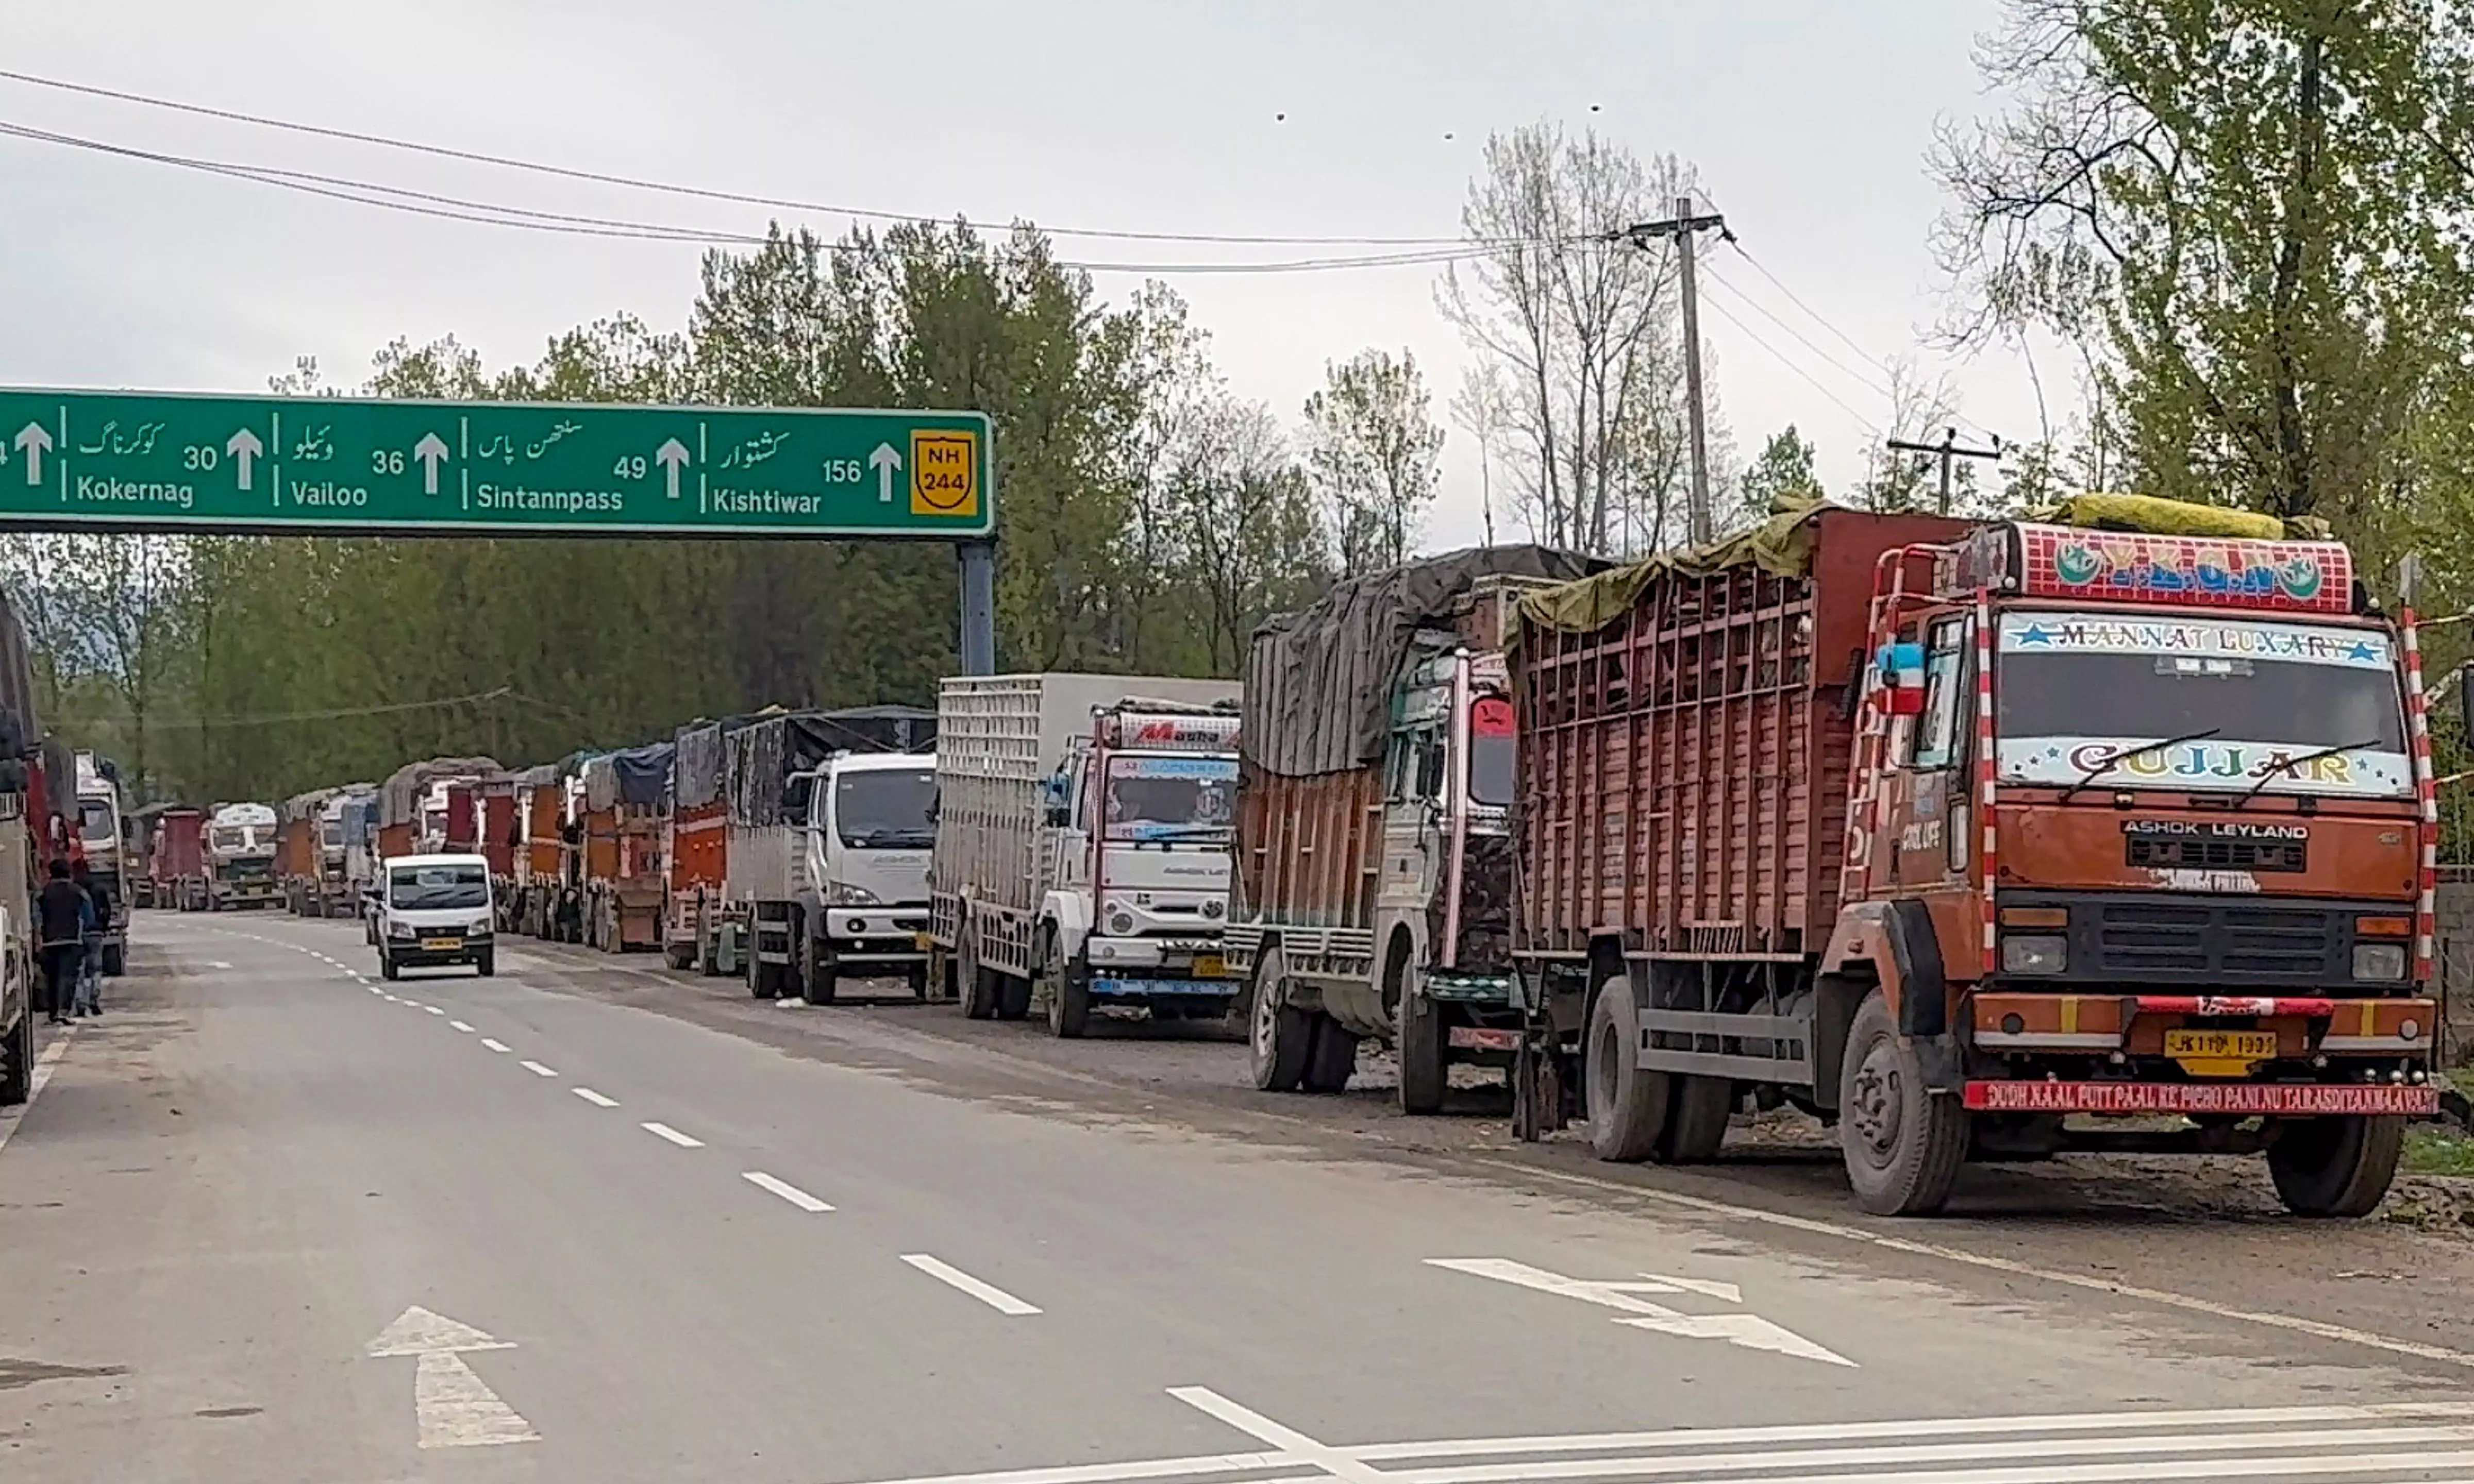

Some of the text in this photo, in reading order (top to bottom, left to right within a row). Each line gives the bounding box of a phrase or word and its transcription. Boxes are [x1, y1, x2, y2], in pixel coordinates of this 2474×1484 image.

[183, 445, 218, 471] 30
[372, 450, 405, 475] 36
[613, 456, 647, 479] 49
[928, 448, 960, 464] NH
[823, 460, 862, 483] 156
[924, 473, 965, 491] 244
[77, 476, 194, 509] Kokernag
[291, 481, 367, 507] Vailoo
[477, 484, 623, 514] Sintannpass
[714, 488, 822, 514] Kishtiwar
[2059, 623, 2209, 650] MANNAT
[2069, 743, 2355, 785] GUJJAR
[2124, 819, 2310, 840] ASHOK LEYLAND
